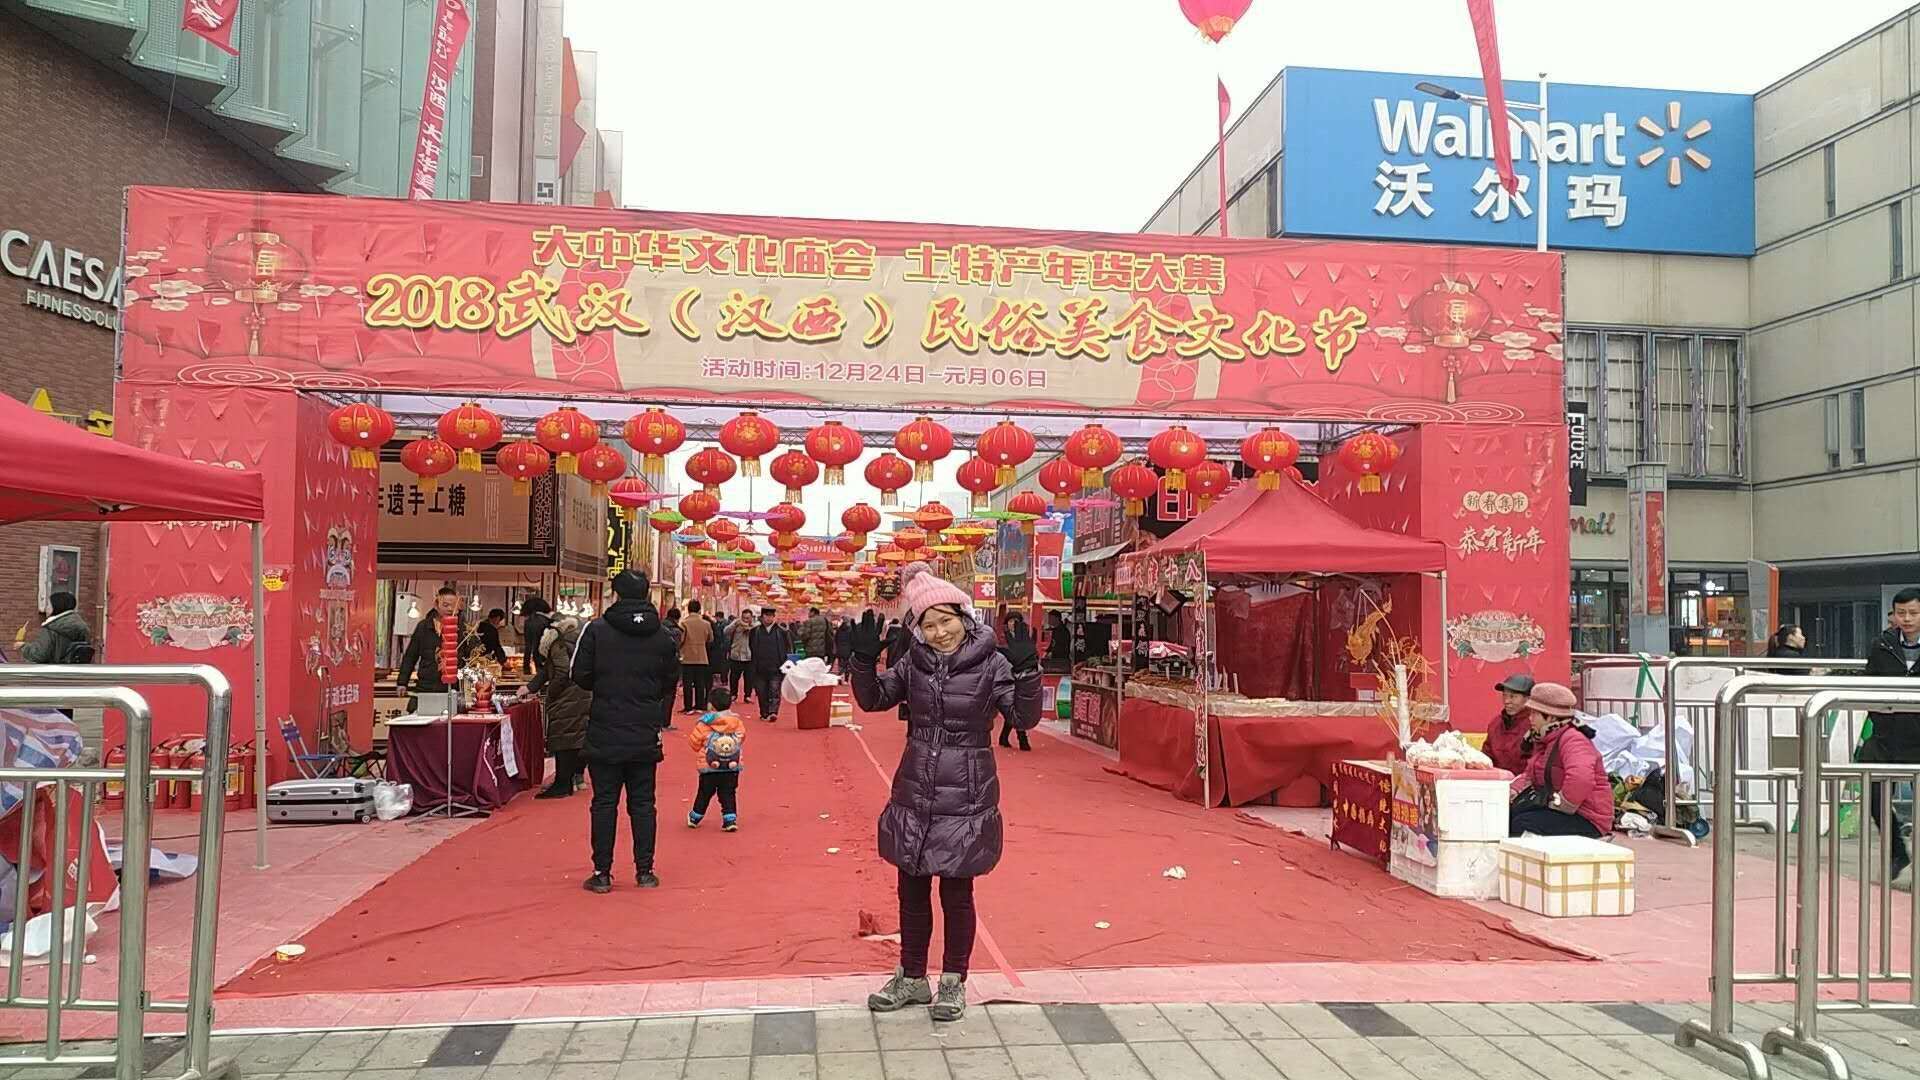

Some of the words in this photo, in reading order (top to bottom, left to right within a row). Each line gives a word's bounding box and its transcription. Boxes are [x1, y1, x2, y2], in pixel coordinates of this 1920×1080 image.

[1372, 97, 1627, 167] Walmart
[1373, 160, 1628, 229] 沃尔玛
[533, 225, 876, 280] 大中华文化庙会
[903, 241, 1226, 295] 土特产年货大集
[26, 288, 92, 322] FITNESS
[1459, 525, 1546, 555] 恭贺新年
